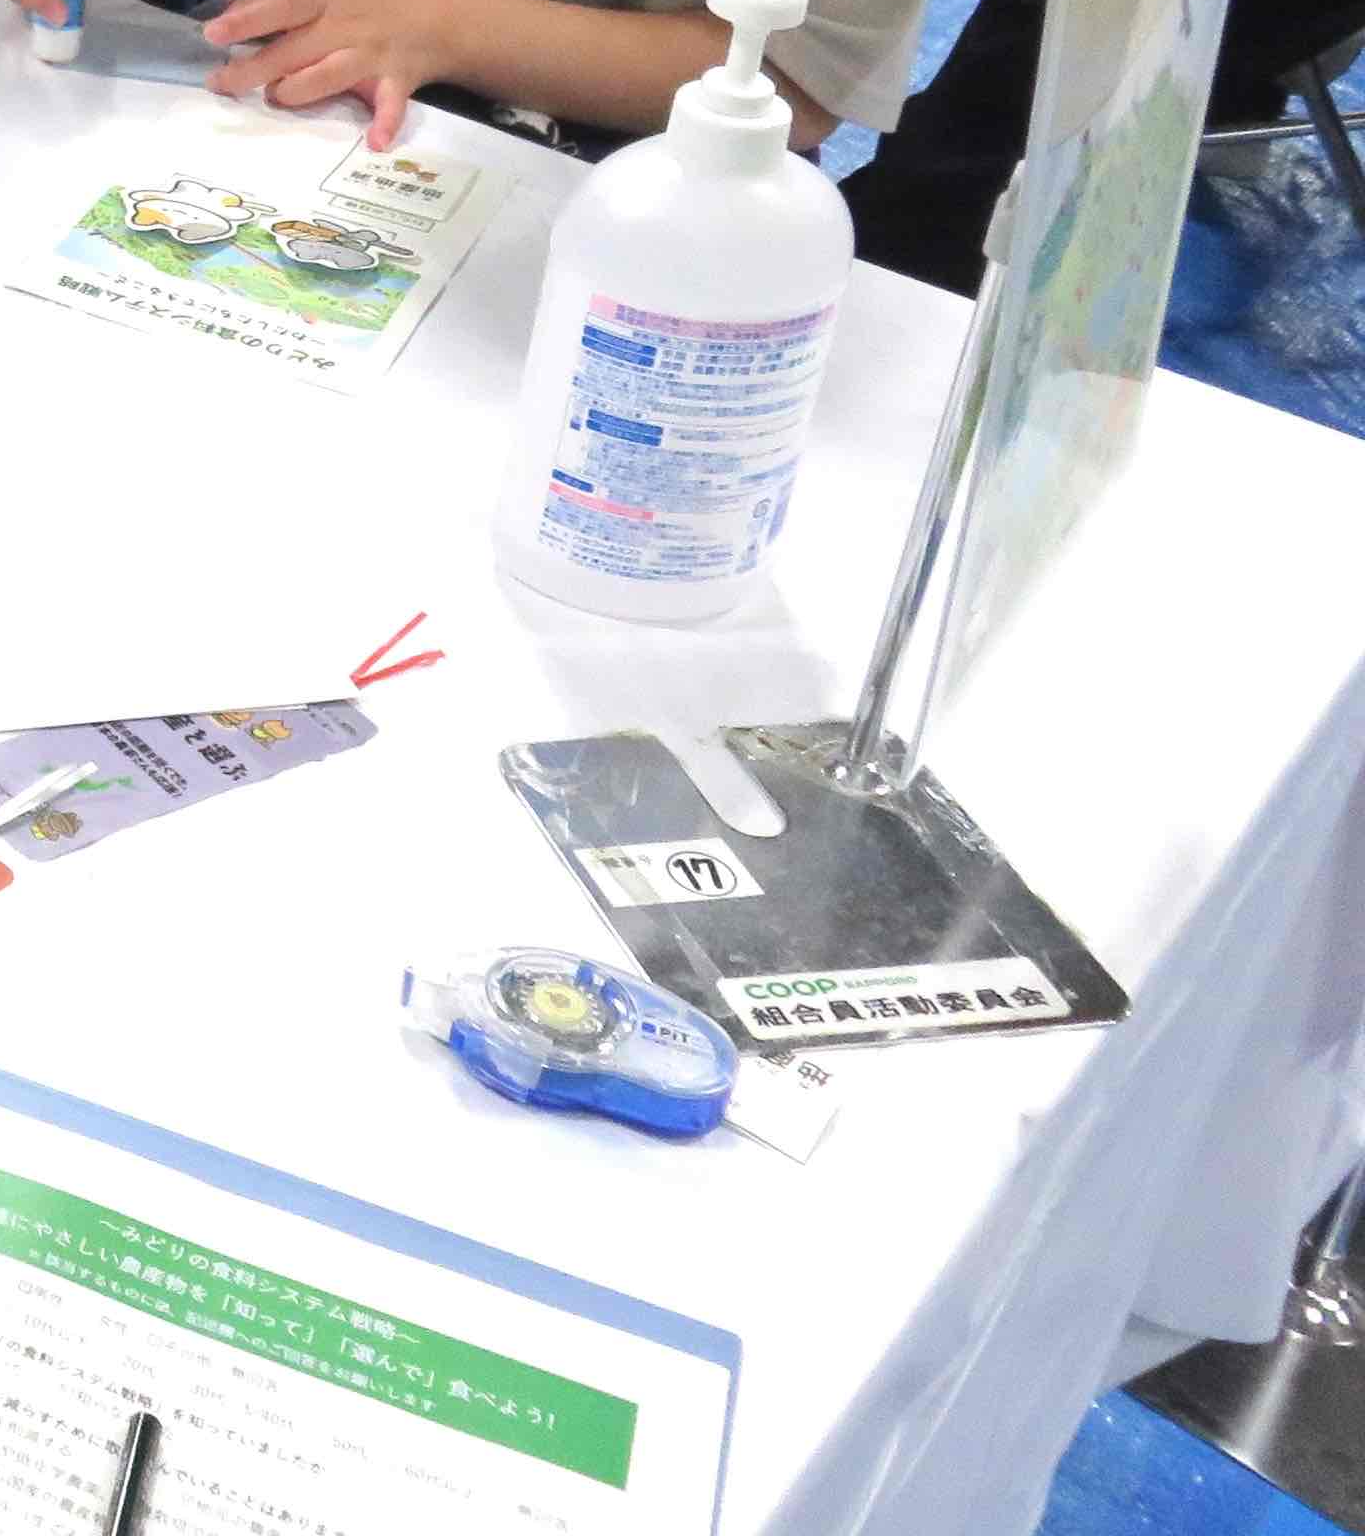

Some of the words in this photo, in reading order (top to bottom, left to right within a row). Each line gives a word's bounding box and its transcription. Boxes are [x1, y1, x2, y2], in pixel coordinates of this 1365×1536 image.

[56, 274, 337, 371] みどりの食料システム戦略
[743, 977, 839, 1001] COOP
[750, 985, 1051, 1029] 組合員活動委員会
